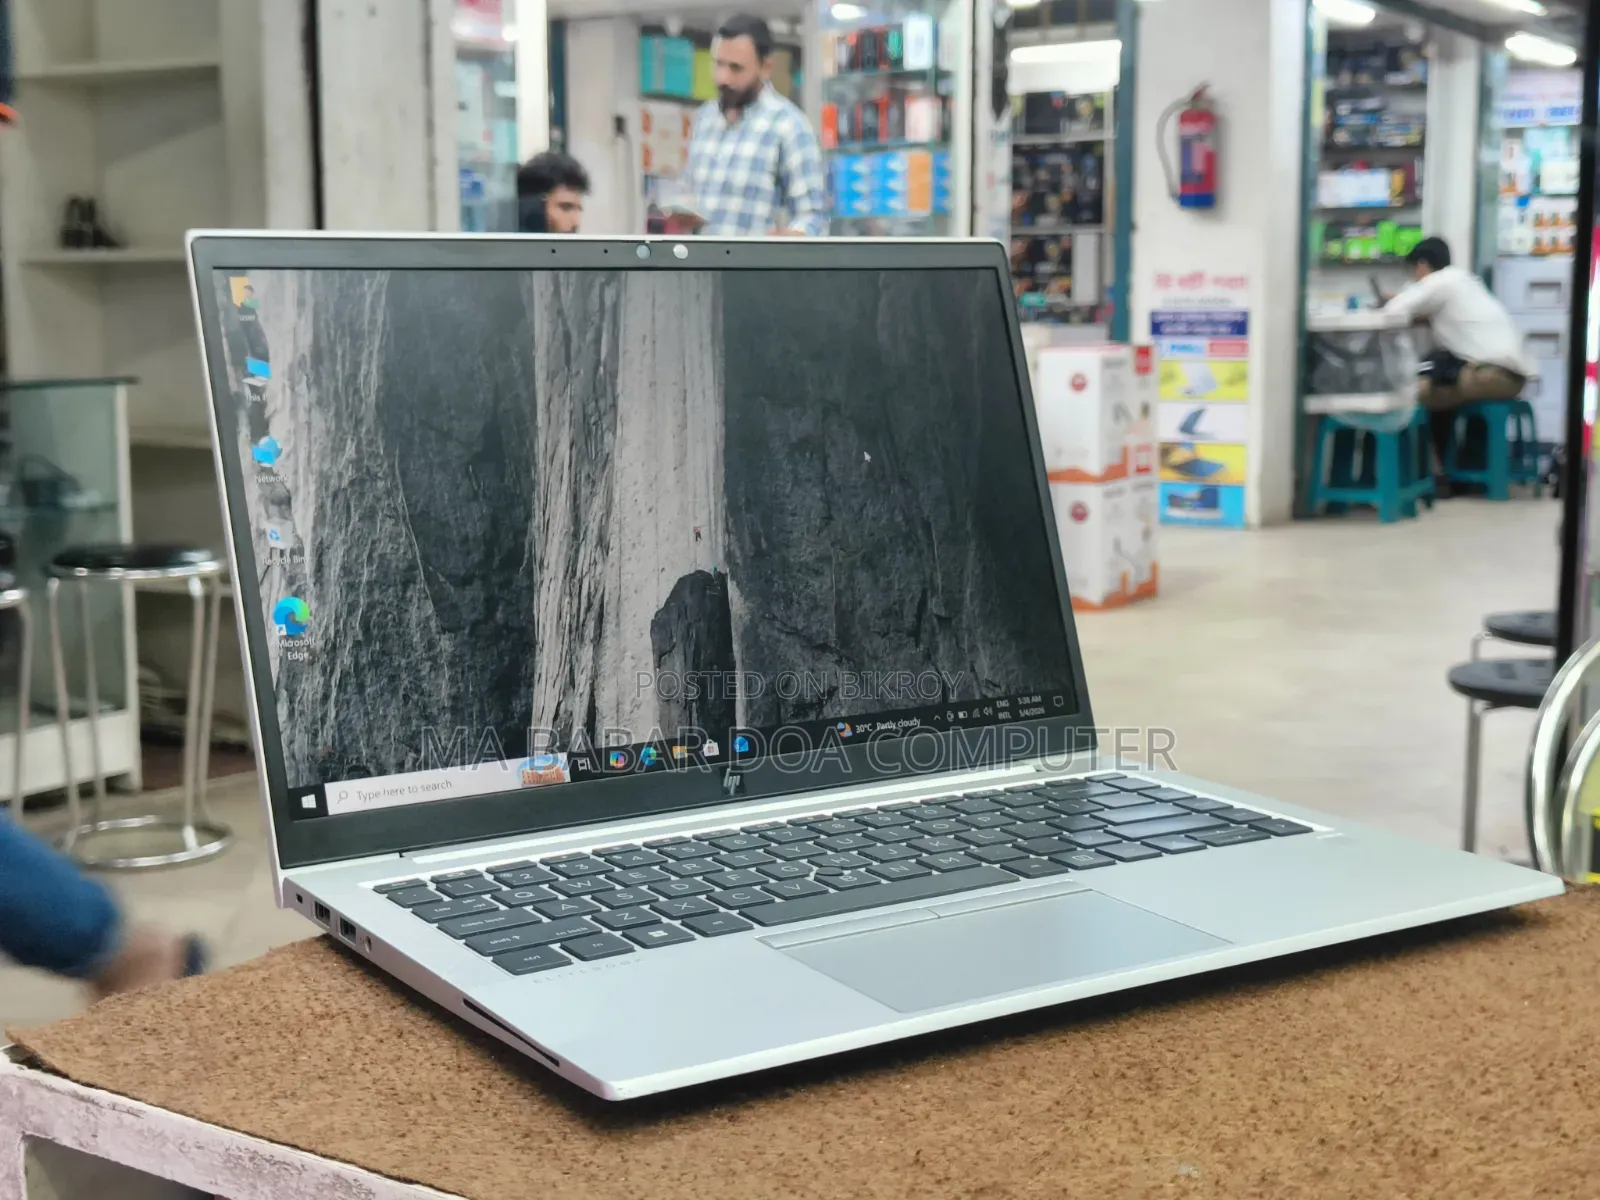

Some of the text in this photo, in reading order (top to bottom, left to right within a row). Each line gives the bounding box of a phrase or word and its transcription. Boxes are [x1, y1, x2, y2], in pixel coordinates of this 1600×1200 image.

[257, 474, 288, 483] Network
[278, 638, 315, 648] Microsoft
[288, 650, 309, 661] Edge
[856, 716, 921, 734] 30°C Partly cloudy
[356, 780, 452, 802] Type here to search
[567, 880, 592, 888] W
[562, 903, 578, 911] A
[616, 912, 636, 920] Z
